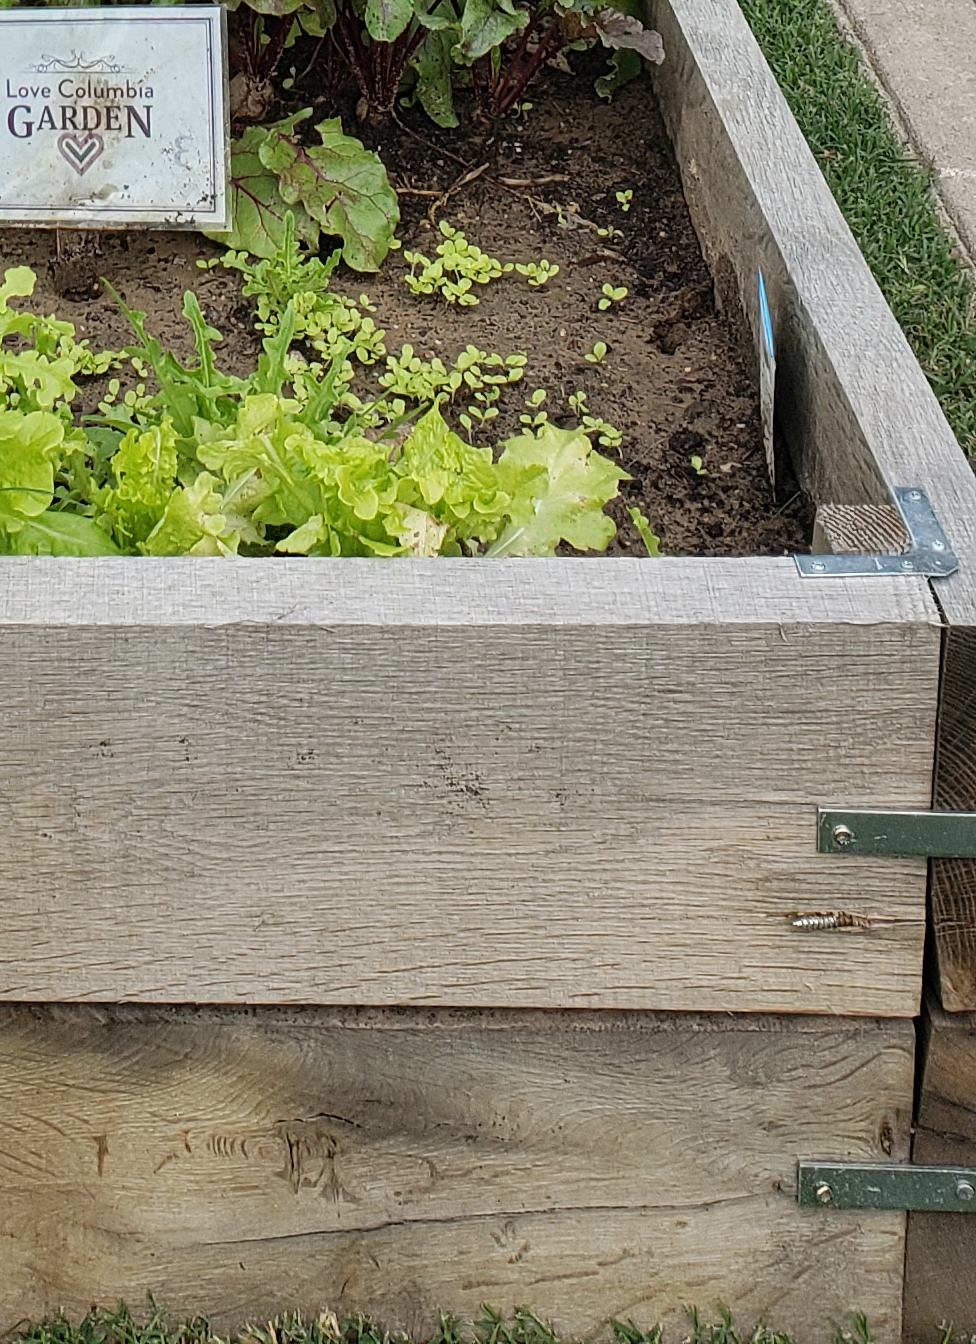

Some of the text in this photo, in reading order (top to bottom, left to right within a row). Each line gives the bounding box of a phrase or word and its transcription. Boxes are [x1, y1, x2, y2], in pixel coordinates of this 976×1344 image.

[6, 78, 154, 99] Love Columbia
[7, 105, 153, 139] GARDEN
